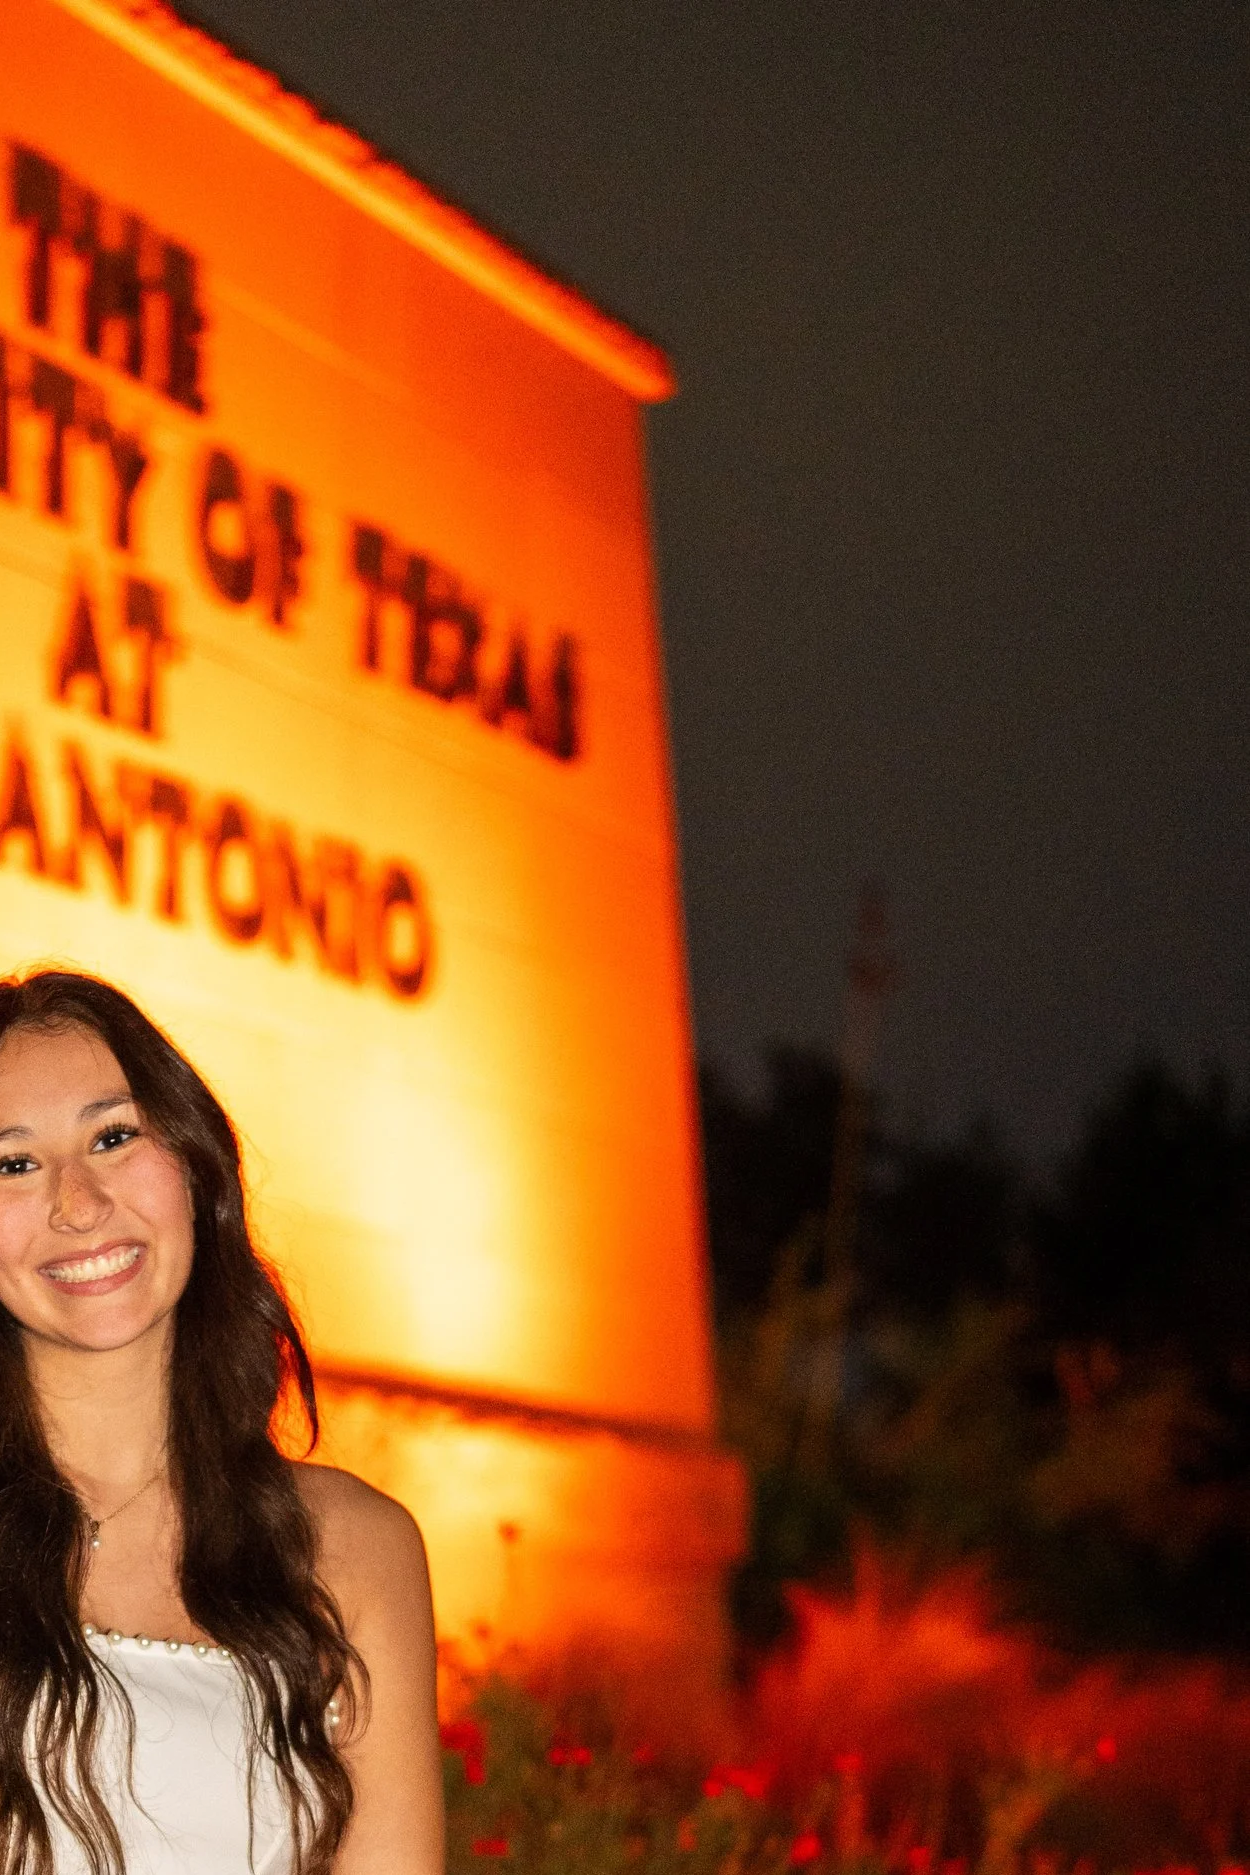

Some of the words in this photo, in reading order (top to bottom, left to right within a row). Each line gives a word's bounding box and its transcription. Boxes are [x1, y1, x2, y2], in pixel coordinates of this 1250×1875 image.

[7, 136, 208, 416] THE
[197, 444, 305, 628] OF
[50, 562, 180, 738] AT
